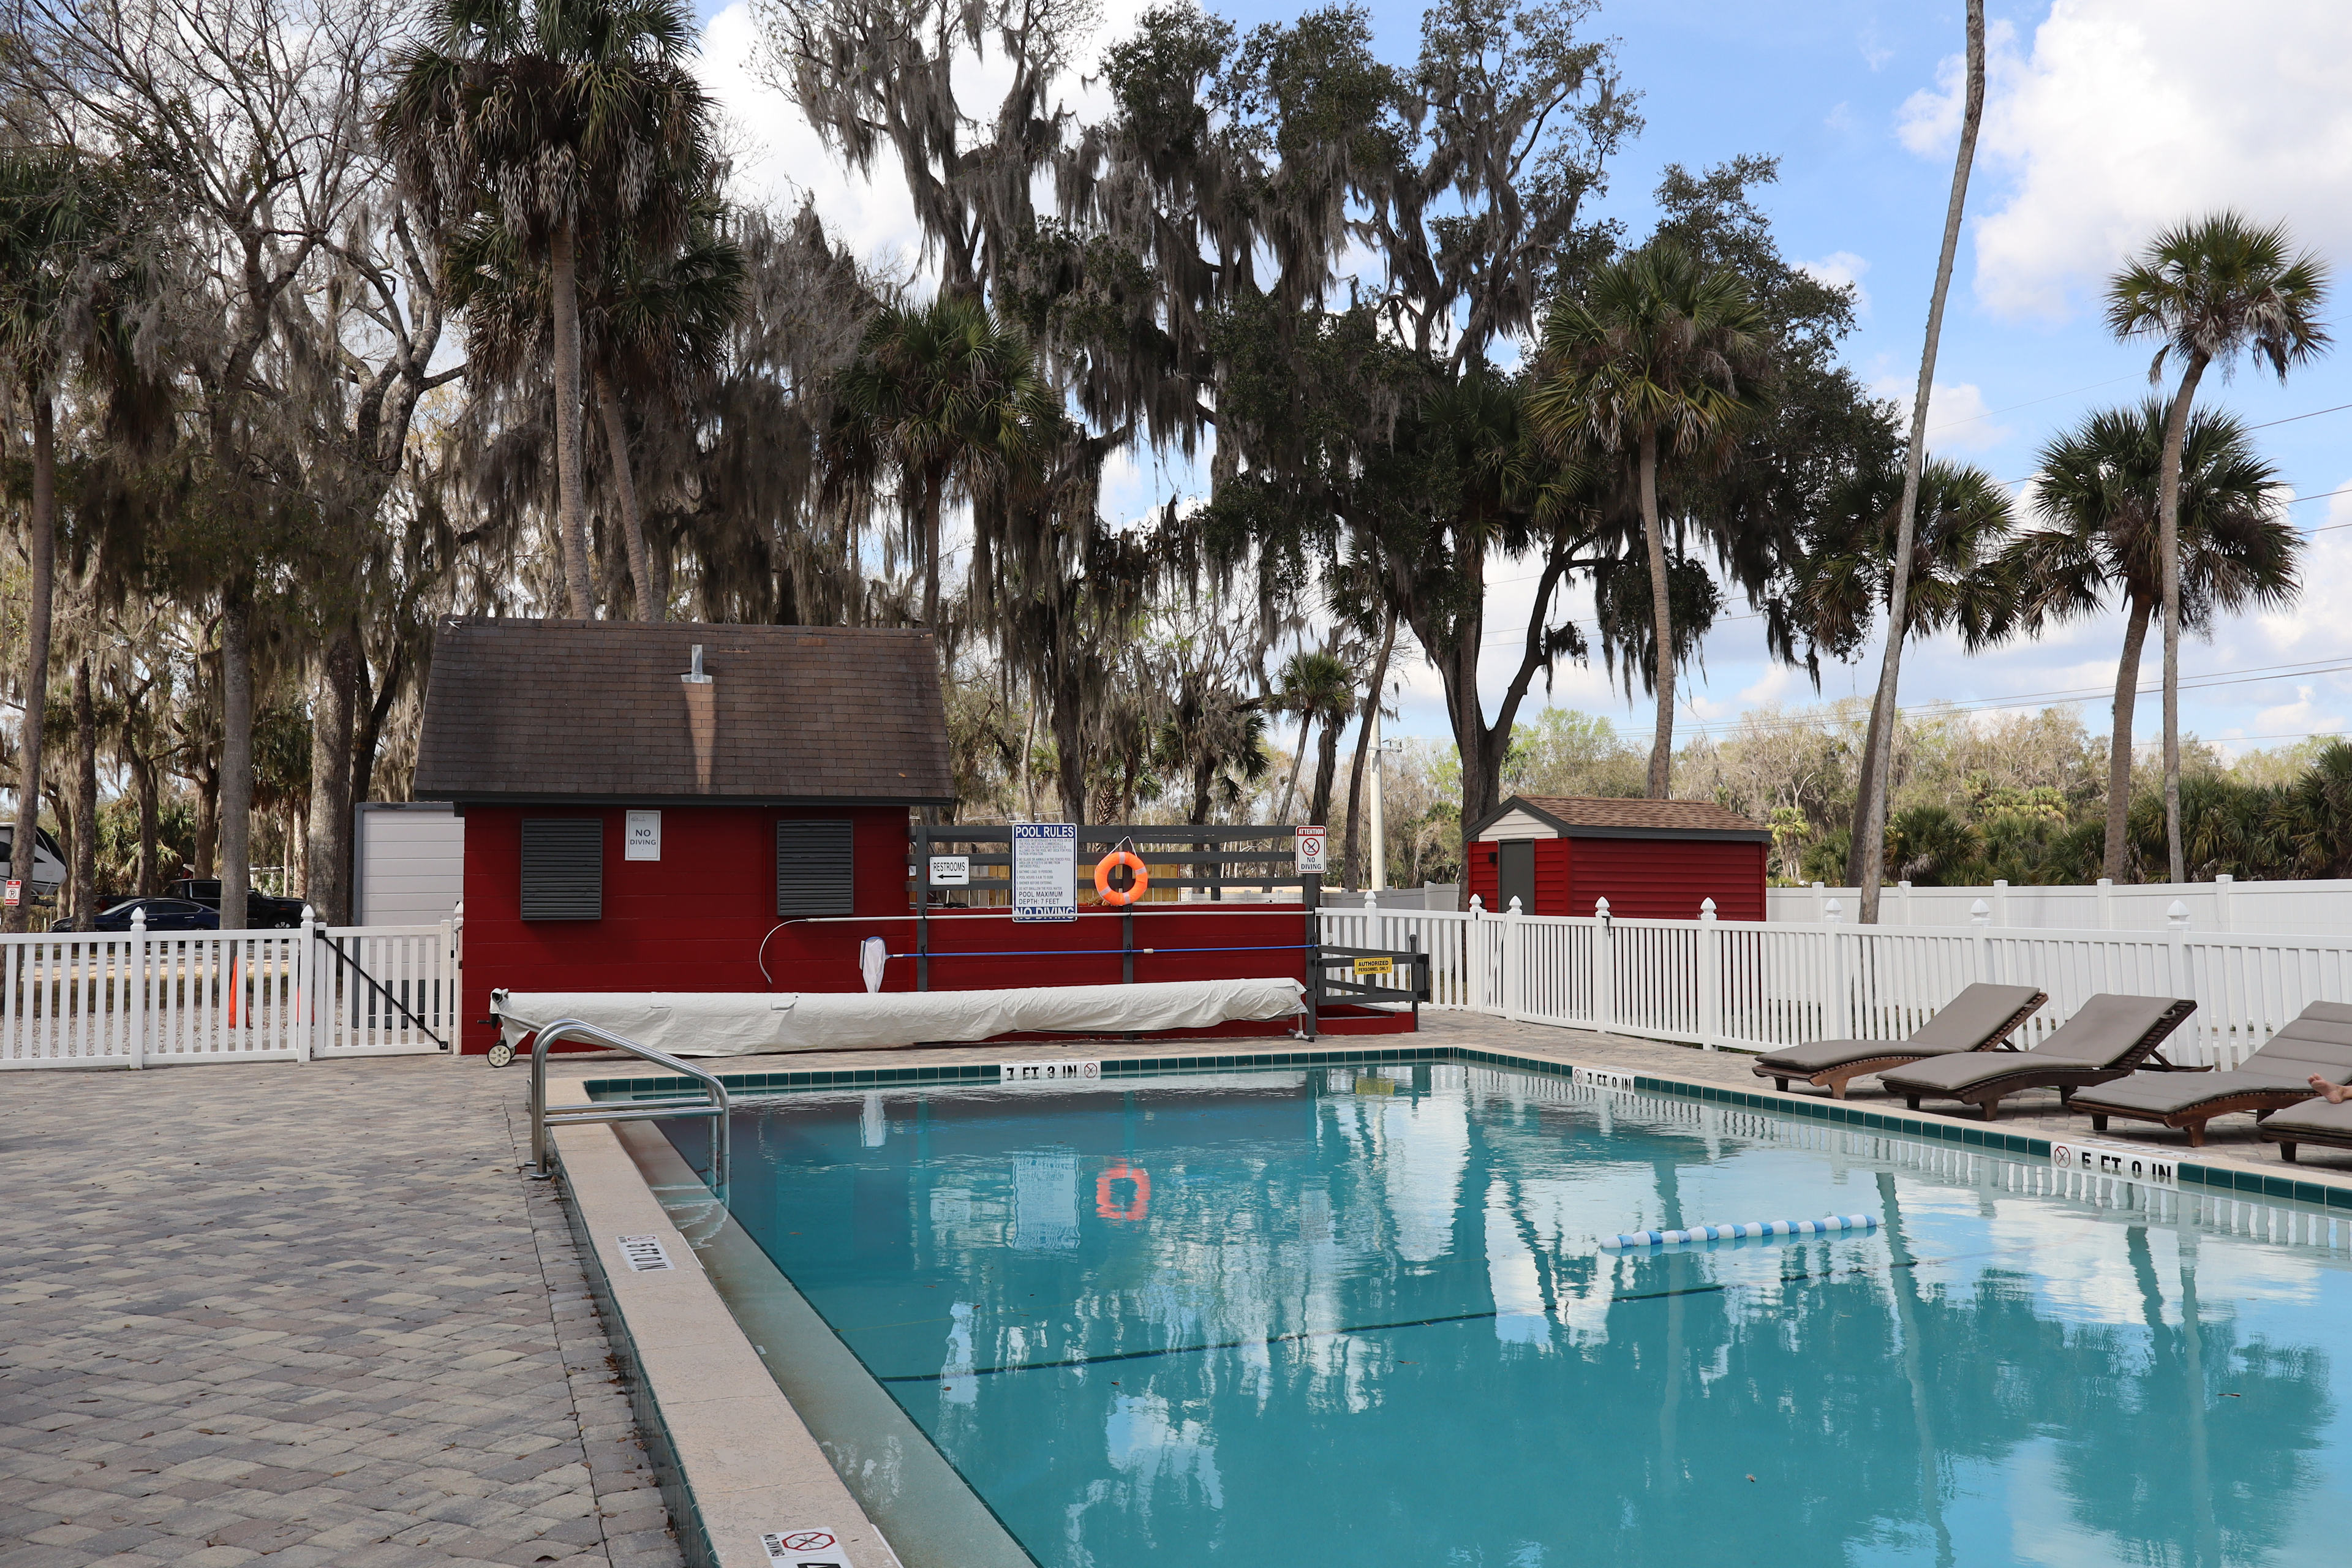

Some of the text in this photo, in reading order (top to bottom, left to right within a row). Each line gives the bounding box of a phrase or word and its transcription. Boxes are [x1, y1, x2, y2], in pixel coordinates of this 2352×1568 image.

[1016, 826, 1074, 837] POOL RULES
[933, 862, 965, 871] RESTROOMS
[1016, 907, 1074, 919] NO DIVING
[635, 1262, 668, 1271] IN
[766, 1541, 785, 1557] DIVING
